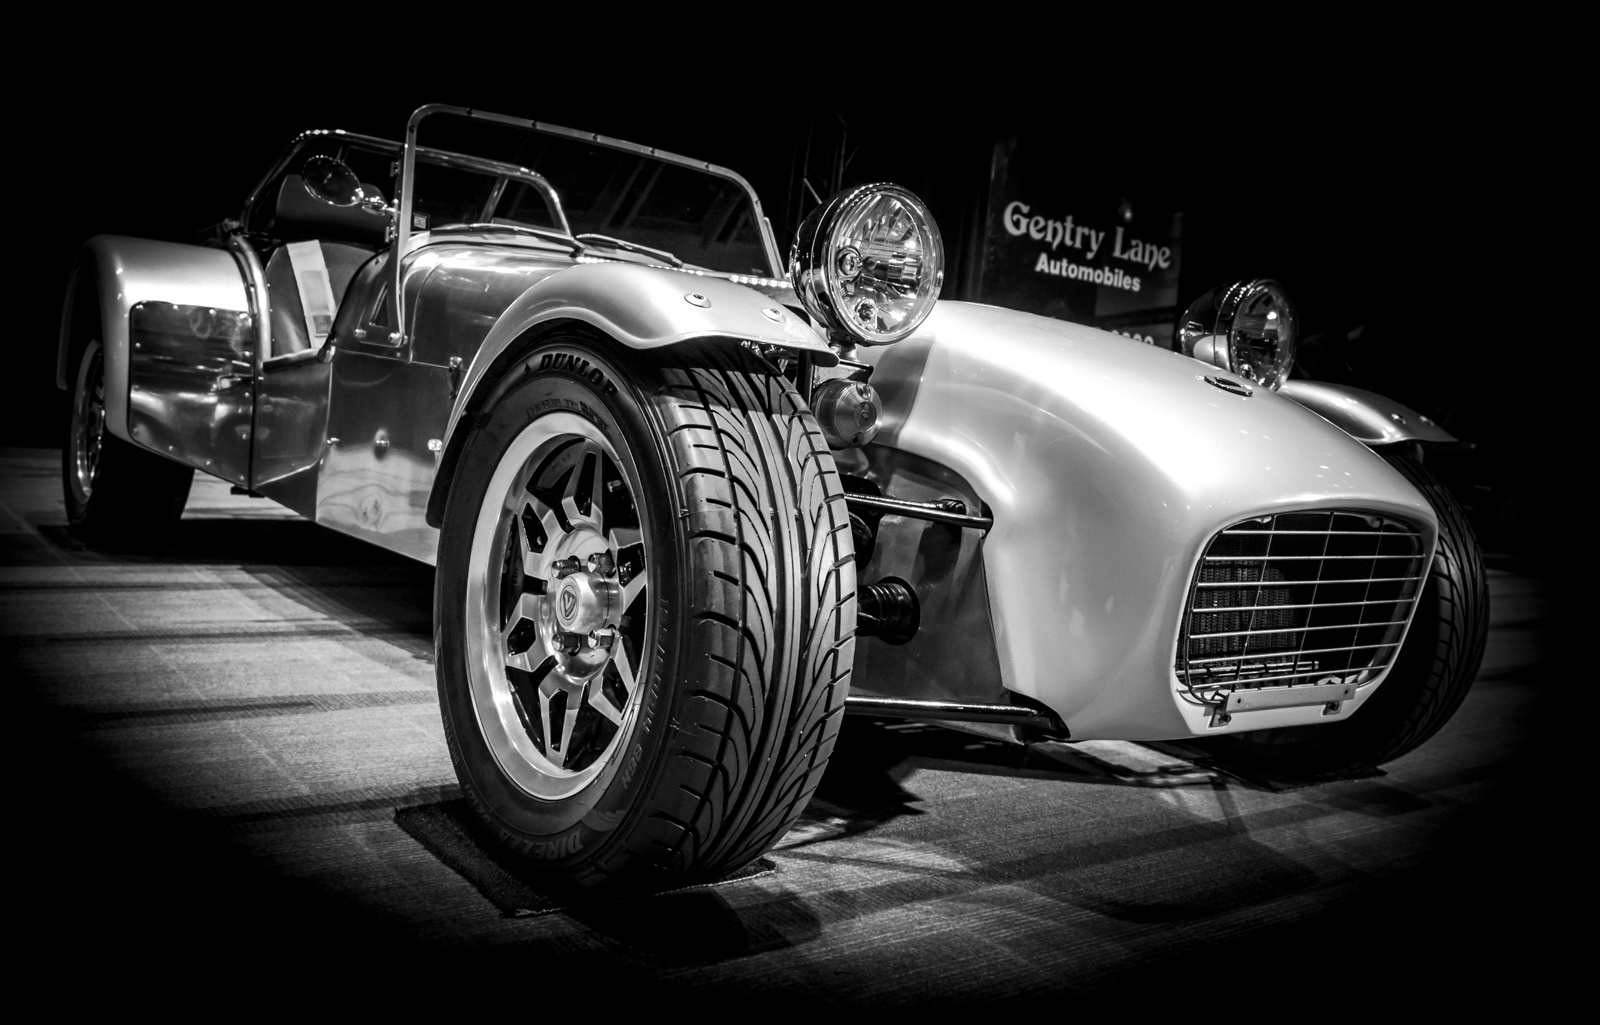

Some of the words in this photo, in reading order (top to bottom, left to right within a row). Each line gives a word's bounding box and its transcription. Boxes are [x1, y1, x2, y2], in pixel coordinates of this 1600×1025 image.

[1003, 200, 1106, 260] Gentry
[1112, 225, 1171, 272] Lane
[1034, 252, 1141, 292] Automobiles
[539, 353, 618, 395] DUNLOP
